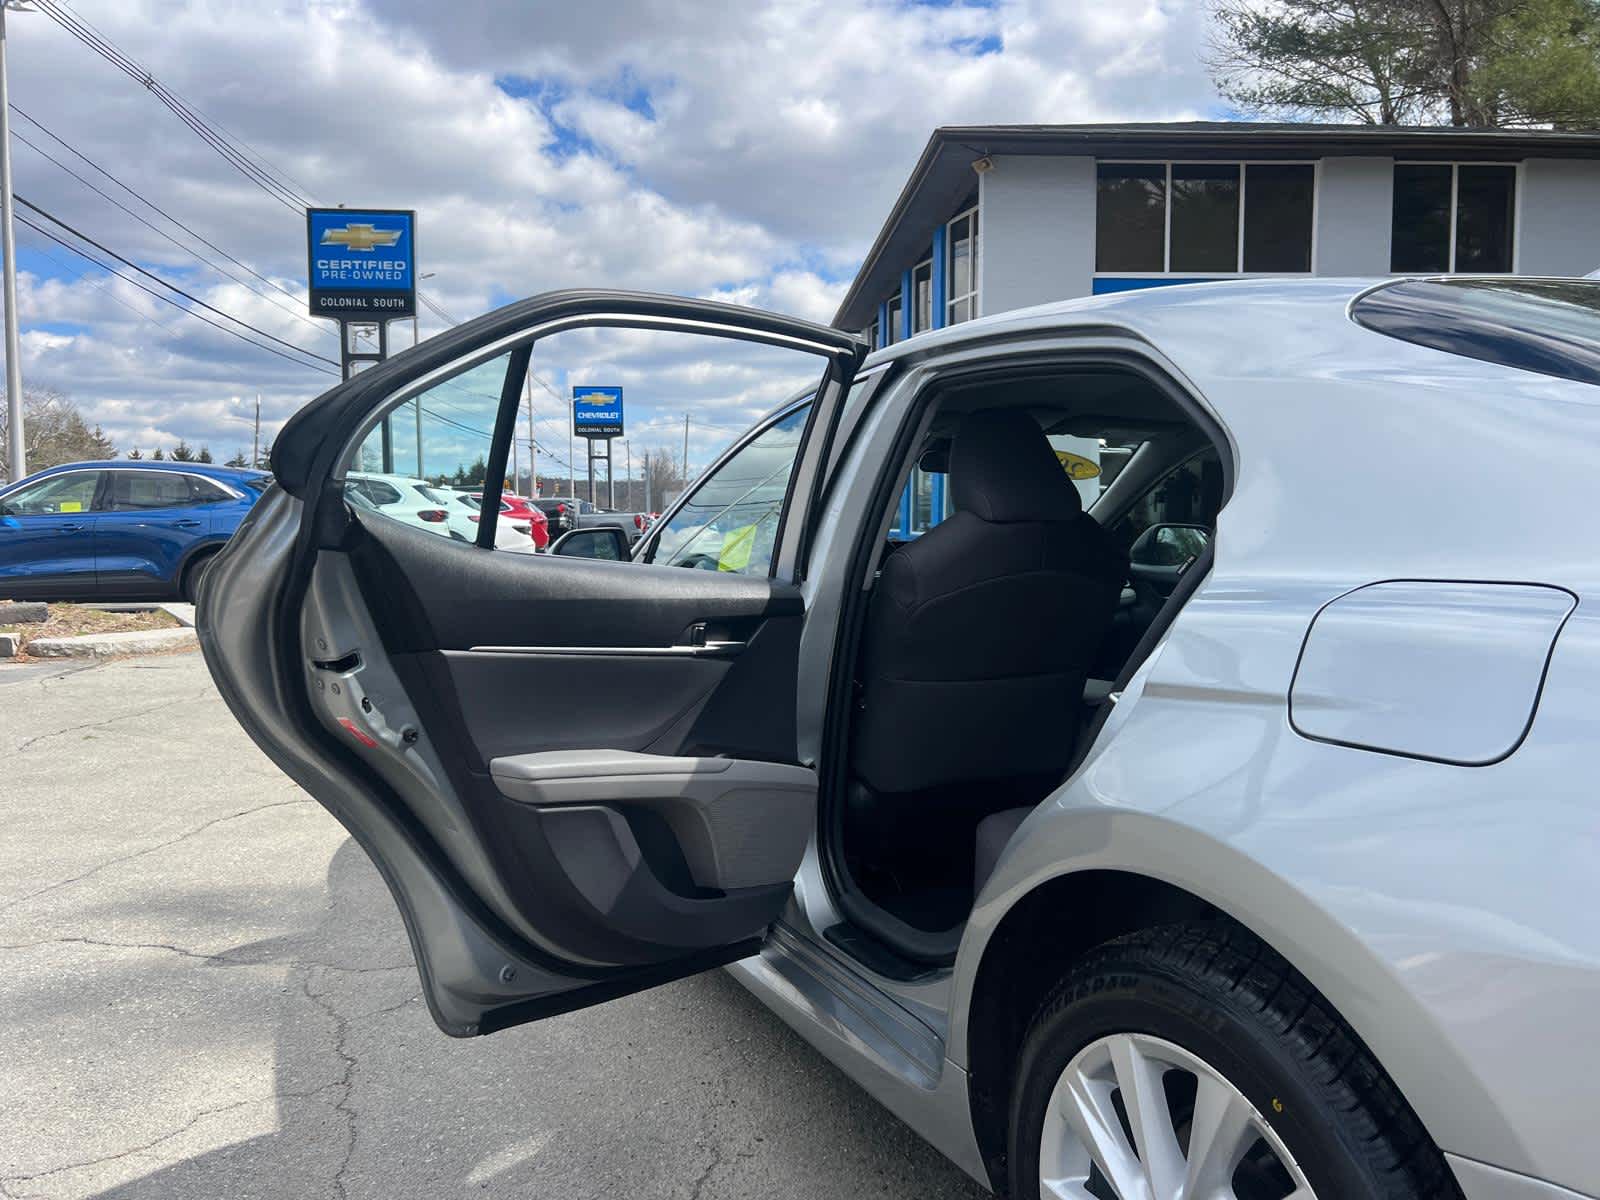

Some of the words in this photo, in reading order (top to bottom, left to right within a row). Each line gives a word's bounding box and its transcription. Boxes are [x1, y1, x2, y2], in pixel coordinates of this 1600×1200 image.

[317, 259, 406, 270] CERTIFIED
[321, 270, 402, 280] PRE-OWNED
[320, 297, 368, 307] COLONIAL
[374, 298, 405, 308] SOUTH
[577, 411, 619, 419] CHEVROLET
